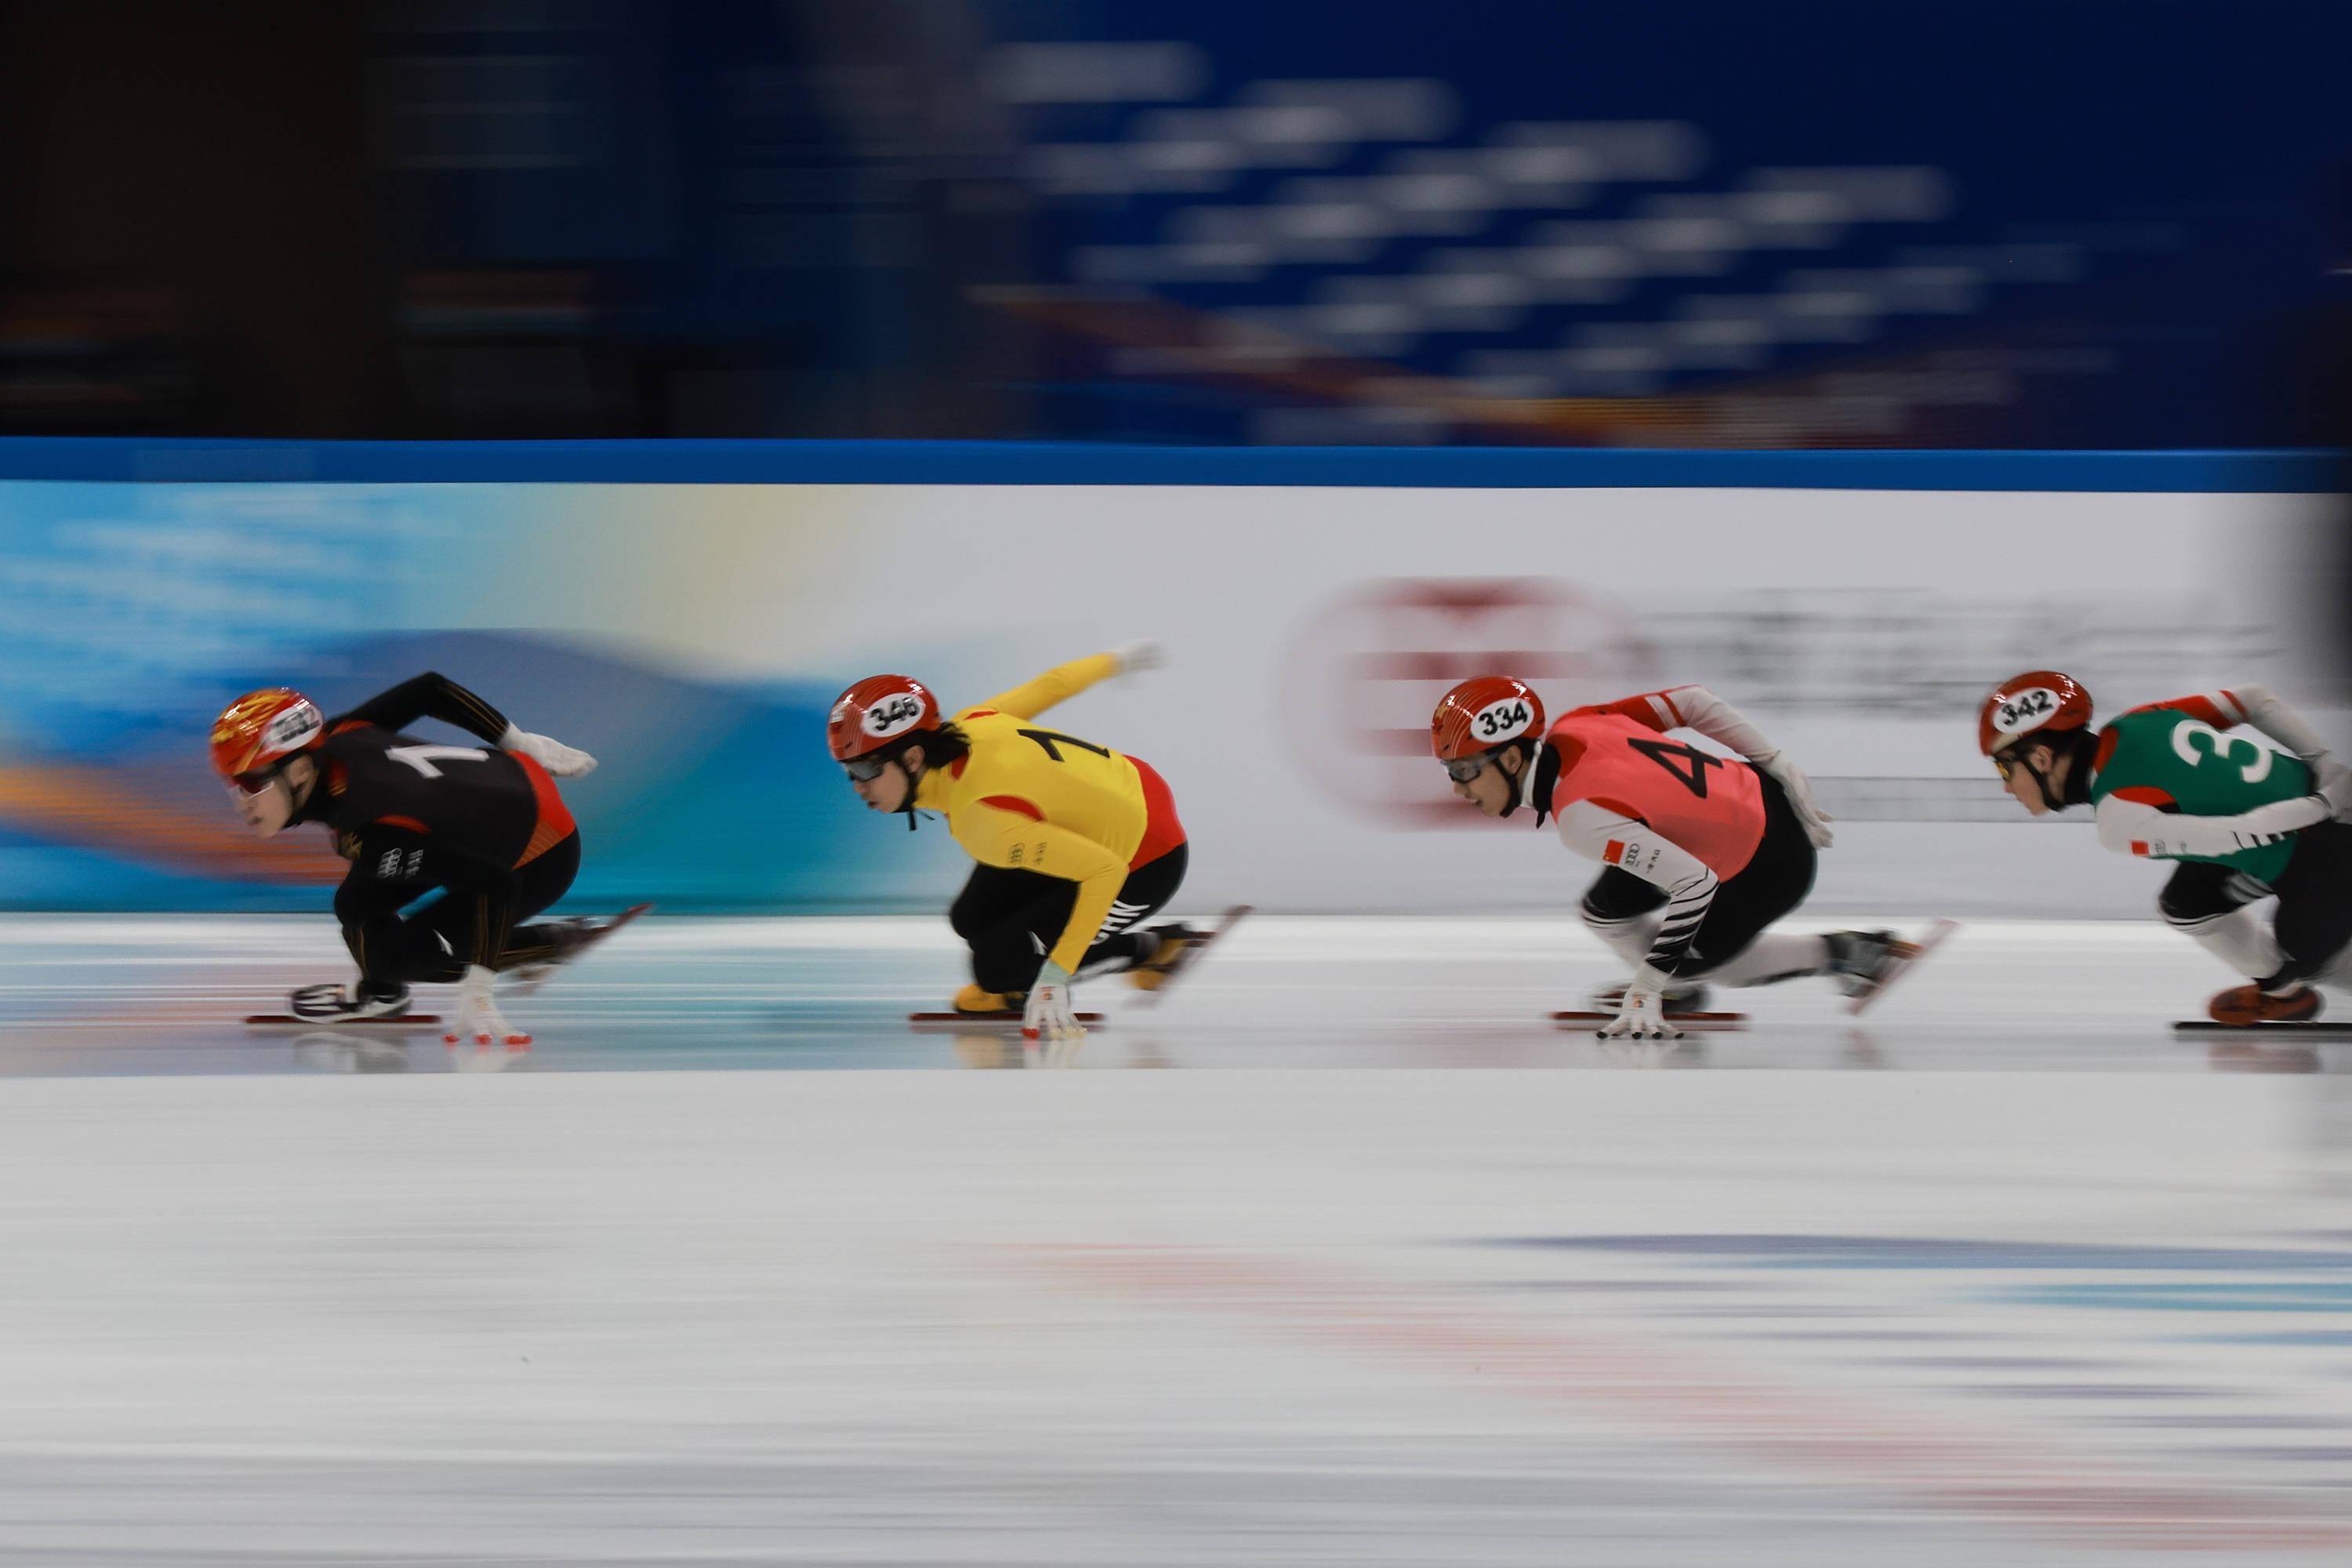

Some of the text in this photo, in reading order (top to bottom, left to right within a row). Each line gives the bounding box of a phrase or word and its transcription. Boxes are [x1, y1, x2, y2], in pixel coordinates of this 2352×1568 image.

[1479, 702, 1528, 735] 334
[2001, 690, 2054, 726] 342
[384, 745, 490, 779] 1
[1016, 728, 1110, 763] 1
[2169, 718, 2274, 783] 3
[1627, 737, 1724, 799] 4
